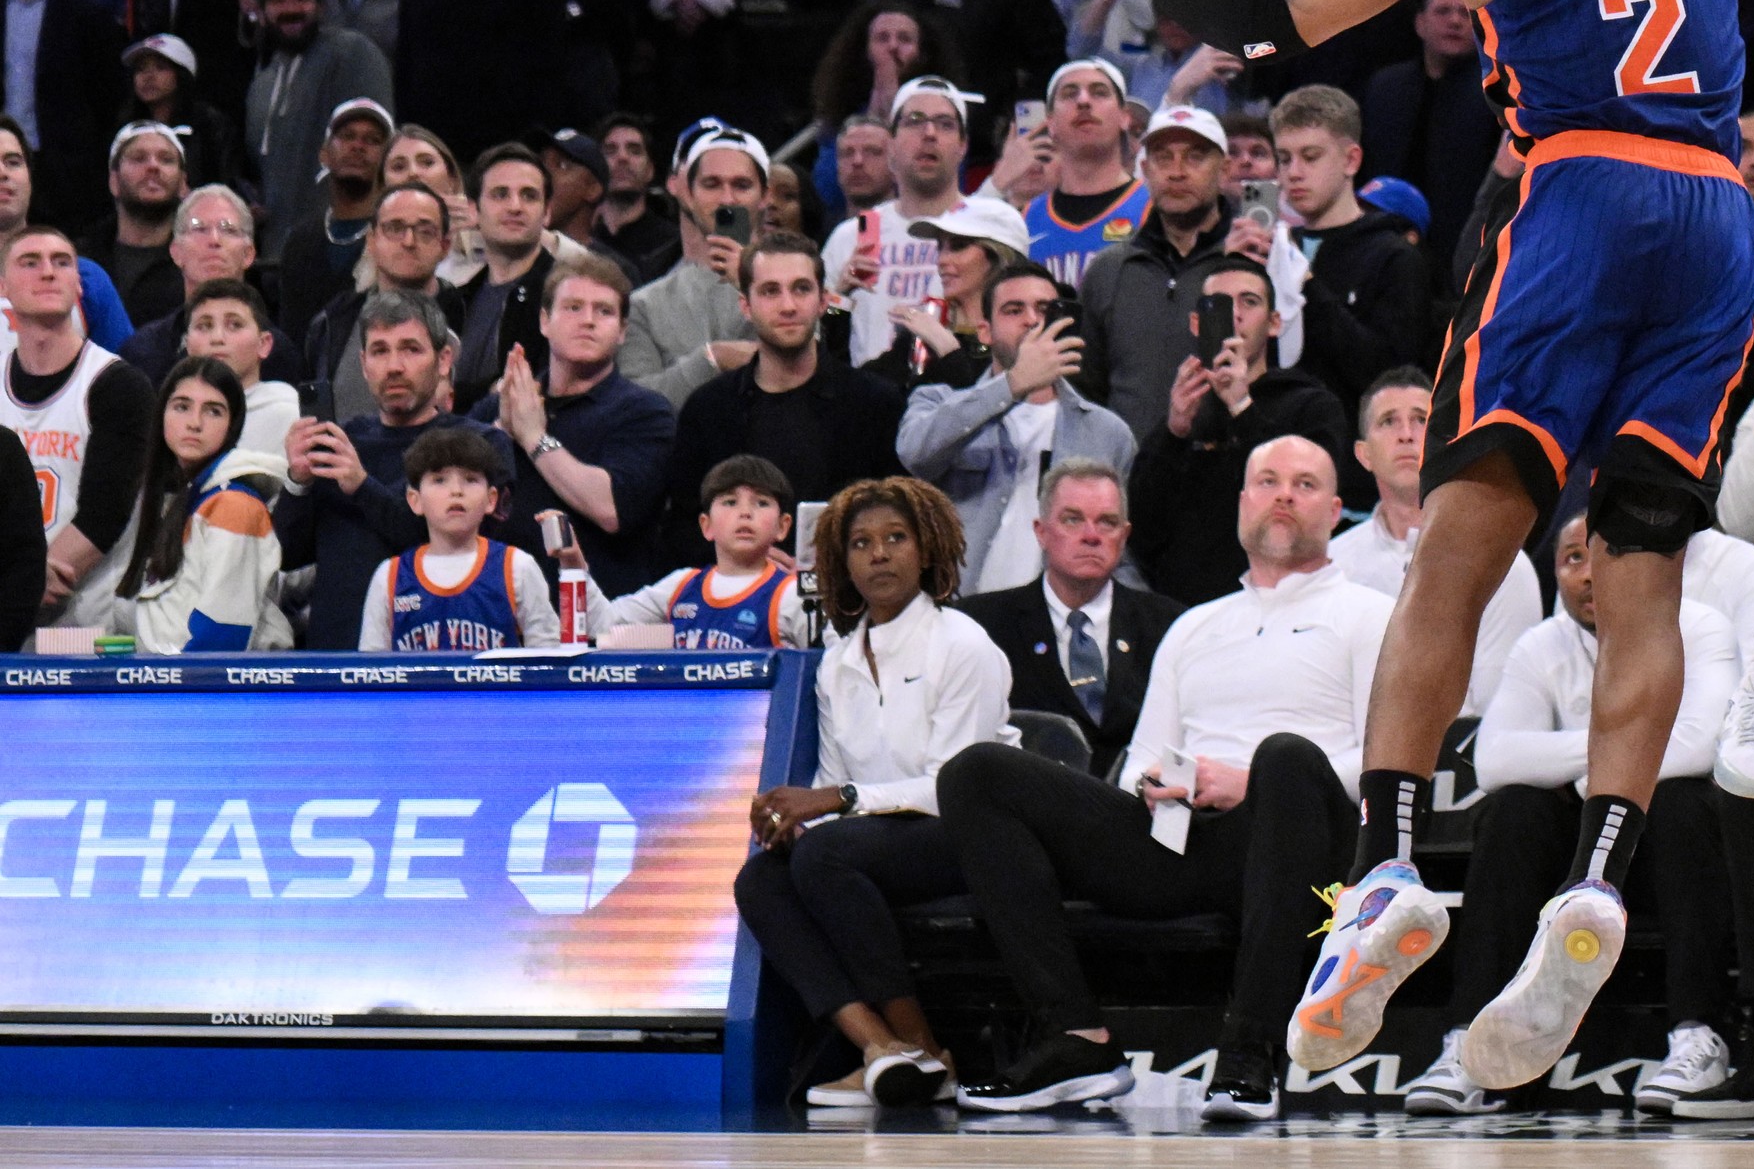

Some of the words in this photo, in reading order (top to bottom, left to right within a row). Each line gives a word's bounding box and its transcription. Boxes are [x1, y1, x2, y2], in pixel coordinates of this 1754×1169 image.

[397, 620, 440, 653] NEW
[446, 618, 506, 651] YORK
[674, 628, 702, 649] EW
[5, 669, 72, 686] CHASE
[116, 666, 182, 684] CHASE
[226, 667, 295, 685] CHASE
[340, 667, 406, 684] CHASE
[453, 665, 522, 683] CHASE
[568, 665, 638, 682] CHASE
[683, 661, 753, 681] CHASE
[0, 799, 482, 899] CHASE
[211, 1012, 334, 1026] DAKTRONICS
